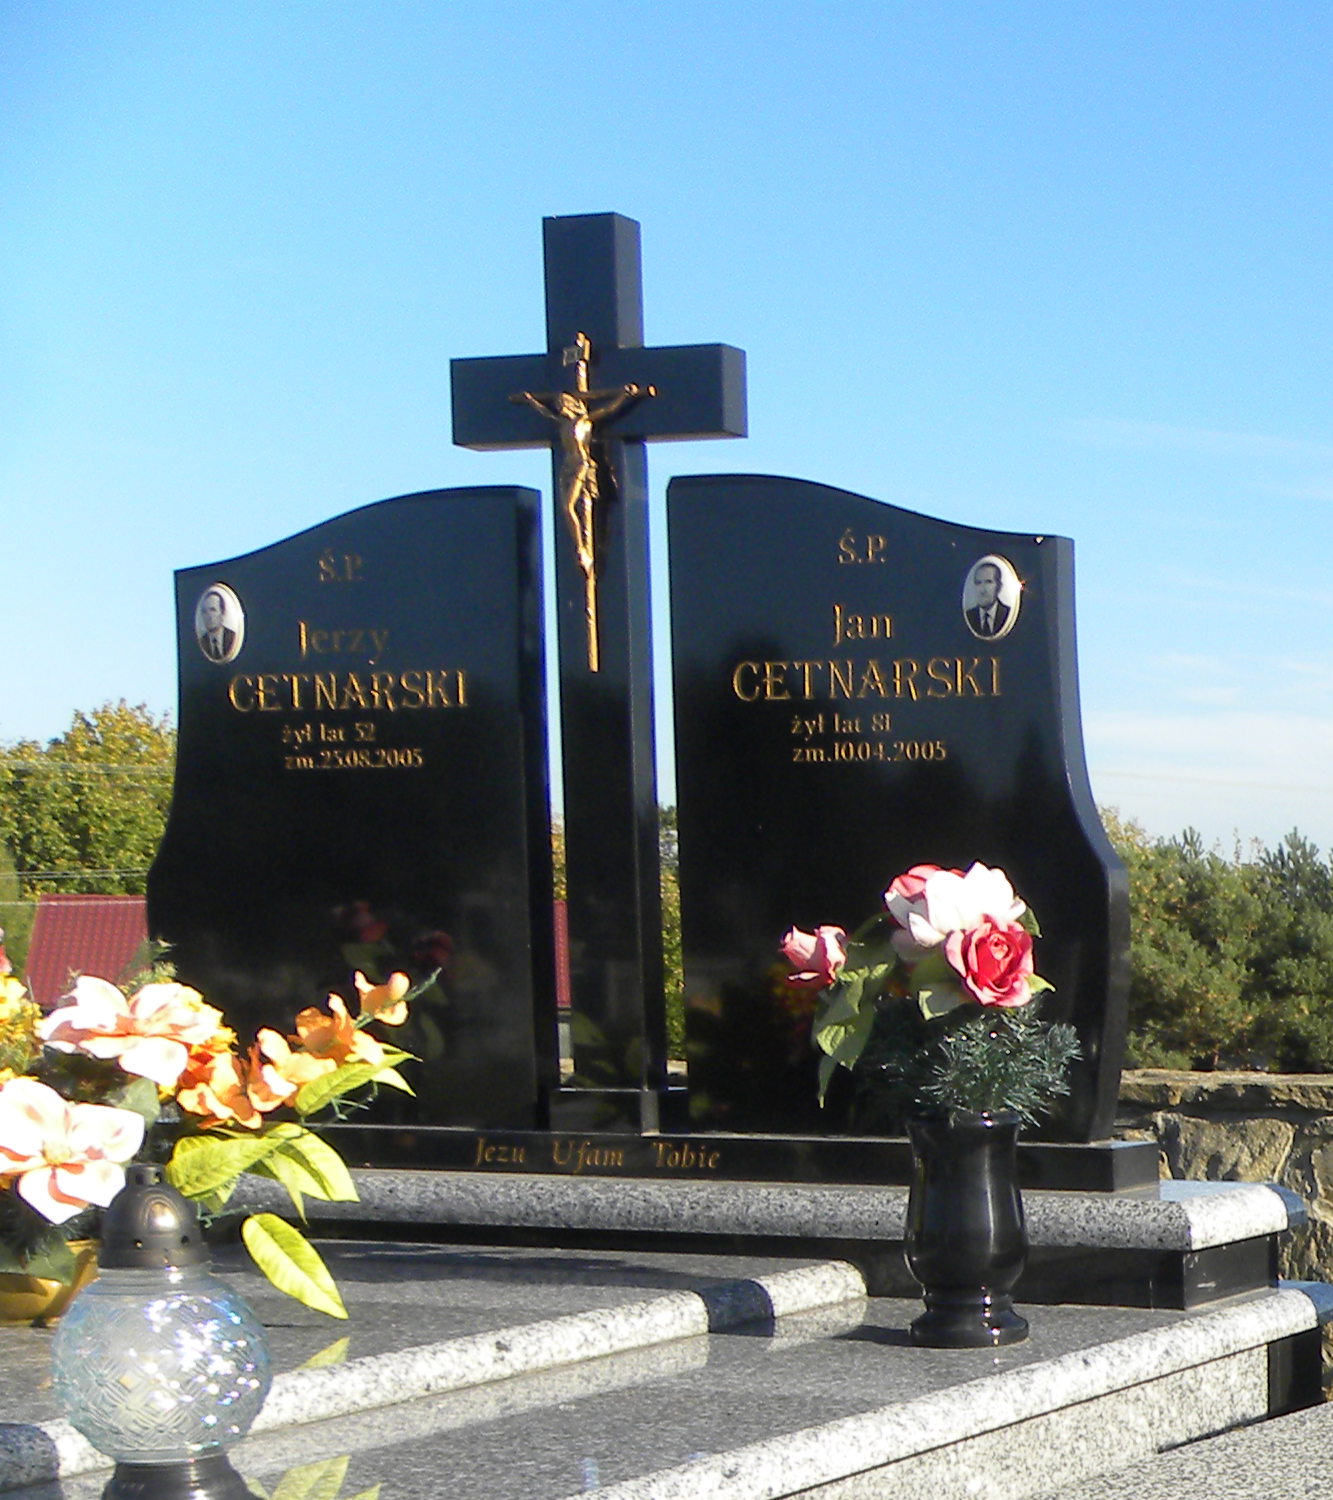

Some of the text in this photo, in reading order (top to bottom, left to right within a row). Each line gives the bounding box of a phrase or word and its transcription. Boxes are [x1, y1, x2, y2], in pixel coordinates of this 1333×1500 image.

[299, 620, 389, 661] Jerzy
[833, 603, 893, 646] Jan
[228, 670, 468, 712] CETNARSKI
[732, 658, 1002, 701] CETNARSKI
[320, 722, 345, 742] lat
[790, 713, 825, 742] żył
[834, 712, 861, 734] lat
[474, 1137, 721, 1174] Jezu Ufam Tobie
